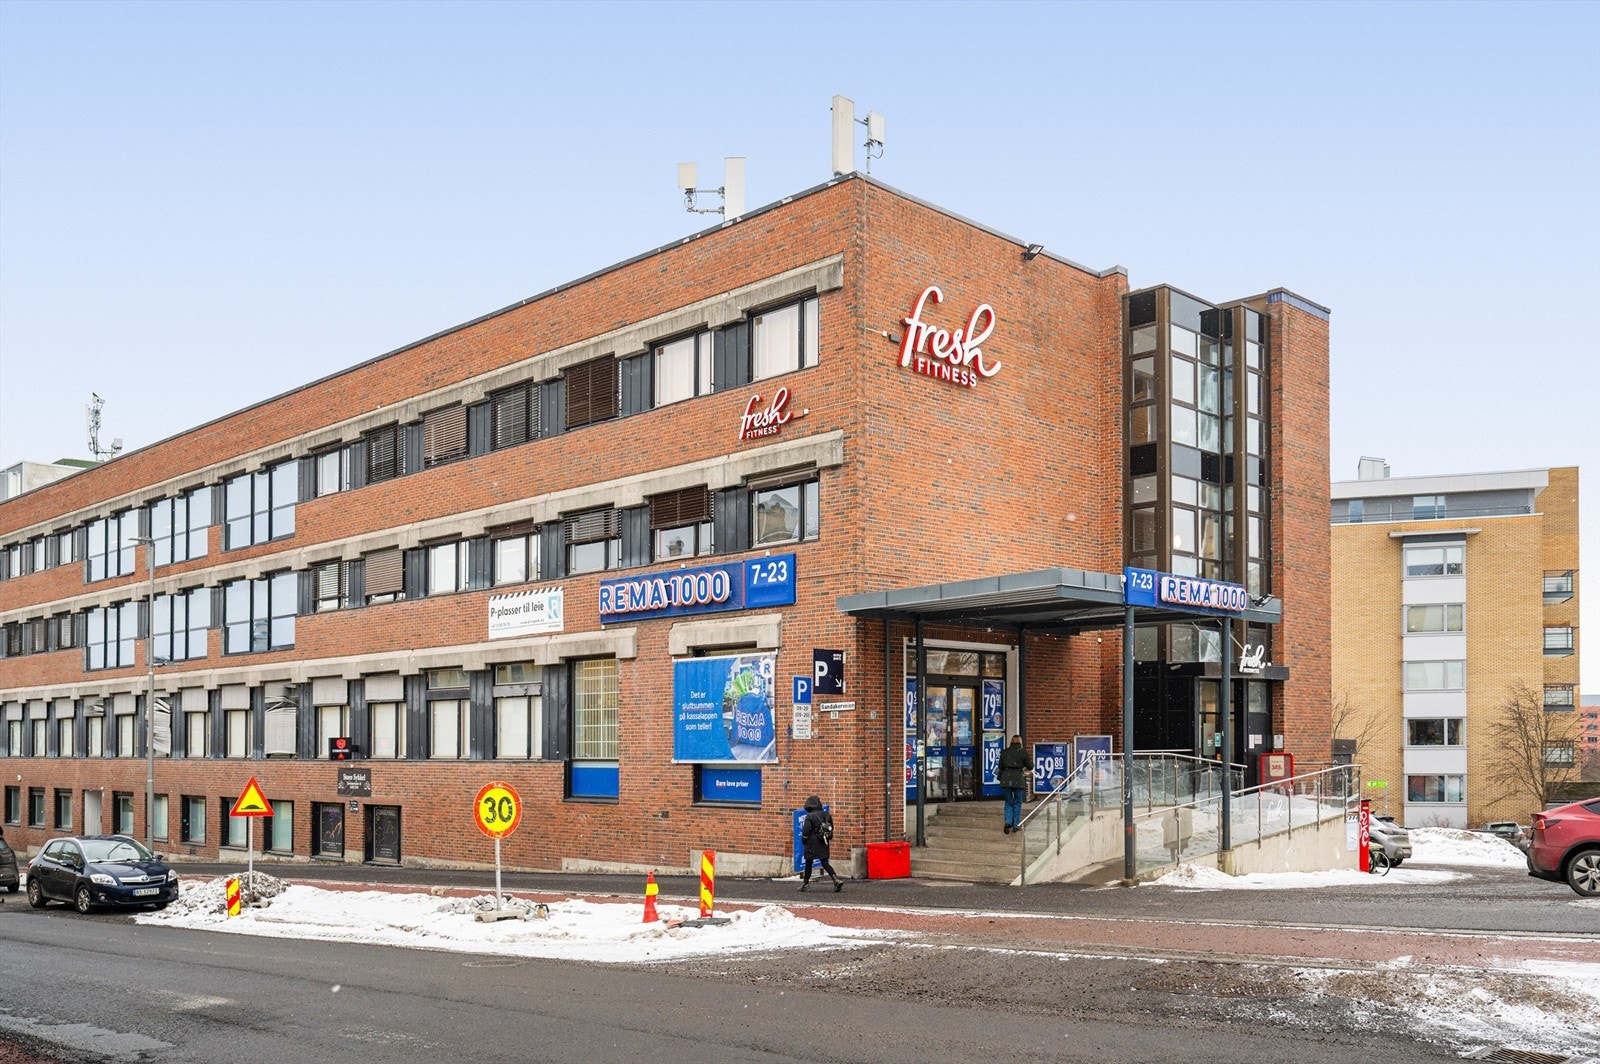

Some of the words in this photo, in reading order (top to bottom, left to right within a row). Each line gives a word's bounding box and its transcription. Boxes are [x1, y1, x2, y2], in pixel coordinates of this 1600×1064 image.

[900, 286, 1001, 377] fresh
[917, 358, 977, 388] FITNESS
[739, 387, 791, 440] fresh
[746, 425, 778, 439] FITNESS
[751, 561, 787, 585] 7-23
[1131, 572, 1153, 589] 7-23
[599, 579, 667, 614] REMA
[669, 570, 730, 607] 1000
[1163, 577, 1211, 605] REMA
[1212, 584, 1247, 611] 1000
[490, 605, 521, 619] P-plasser
[522, 603, 530, 613] til
[531, 601, 545, 611] leie
[763, 663, 771, 674] R
[815, 660, 829, 687] P
[690, 691, 700, 699] Det
[797, 680, 808, 700] P
[736, 709, 765, 727] REMA
[738, 726, 762, 741] 1000
[1036, 757, 1054, 780] 59
[736, 780, 749, 788] priser
[483, 796, 513, 823] 30
